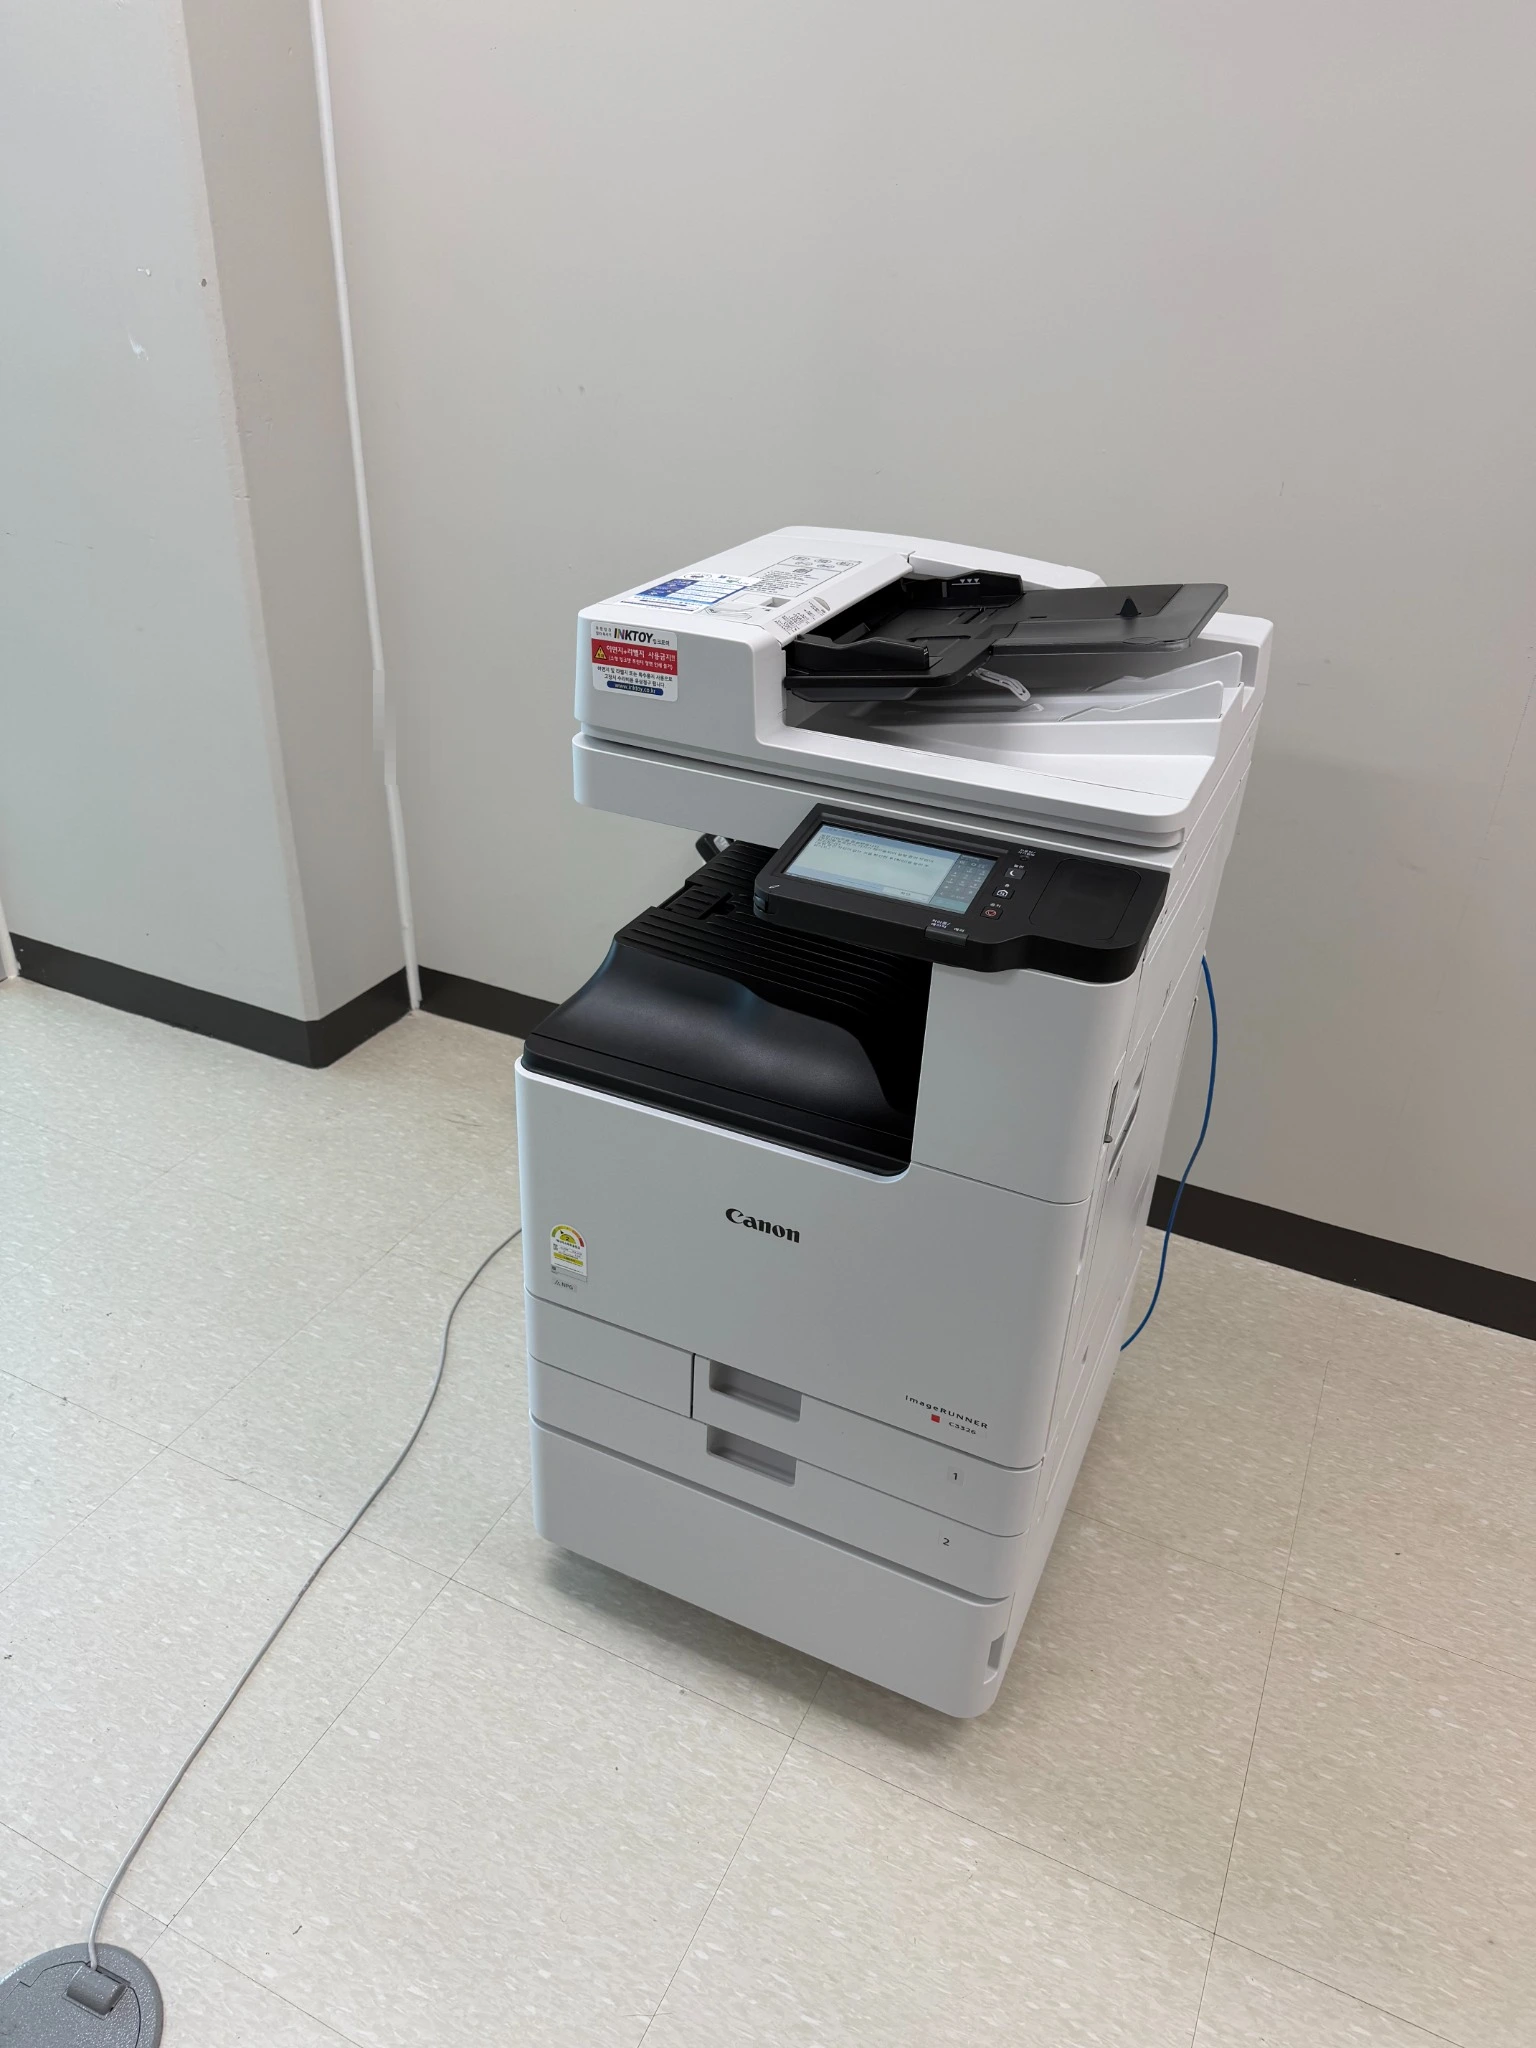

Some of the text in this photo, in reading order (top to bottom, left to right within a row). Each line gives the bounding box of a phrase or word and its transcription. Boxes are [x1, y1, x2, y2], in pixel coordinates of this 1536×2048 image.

[614, 628, 653, 643] INKTOY
[725, 1208, 800, 1244] Canon
[905, 1394, 988, 1430] imageRUNNER
[948, 1421, 977, 1435] C3326
[953, 1472, 958, 1481] 1
[942, 1537, 950, 1546] 2
